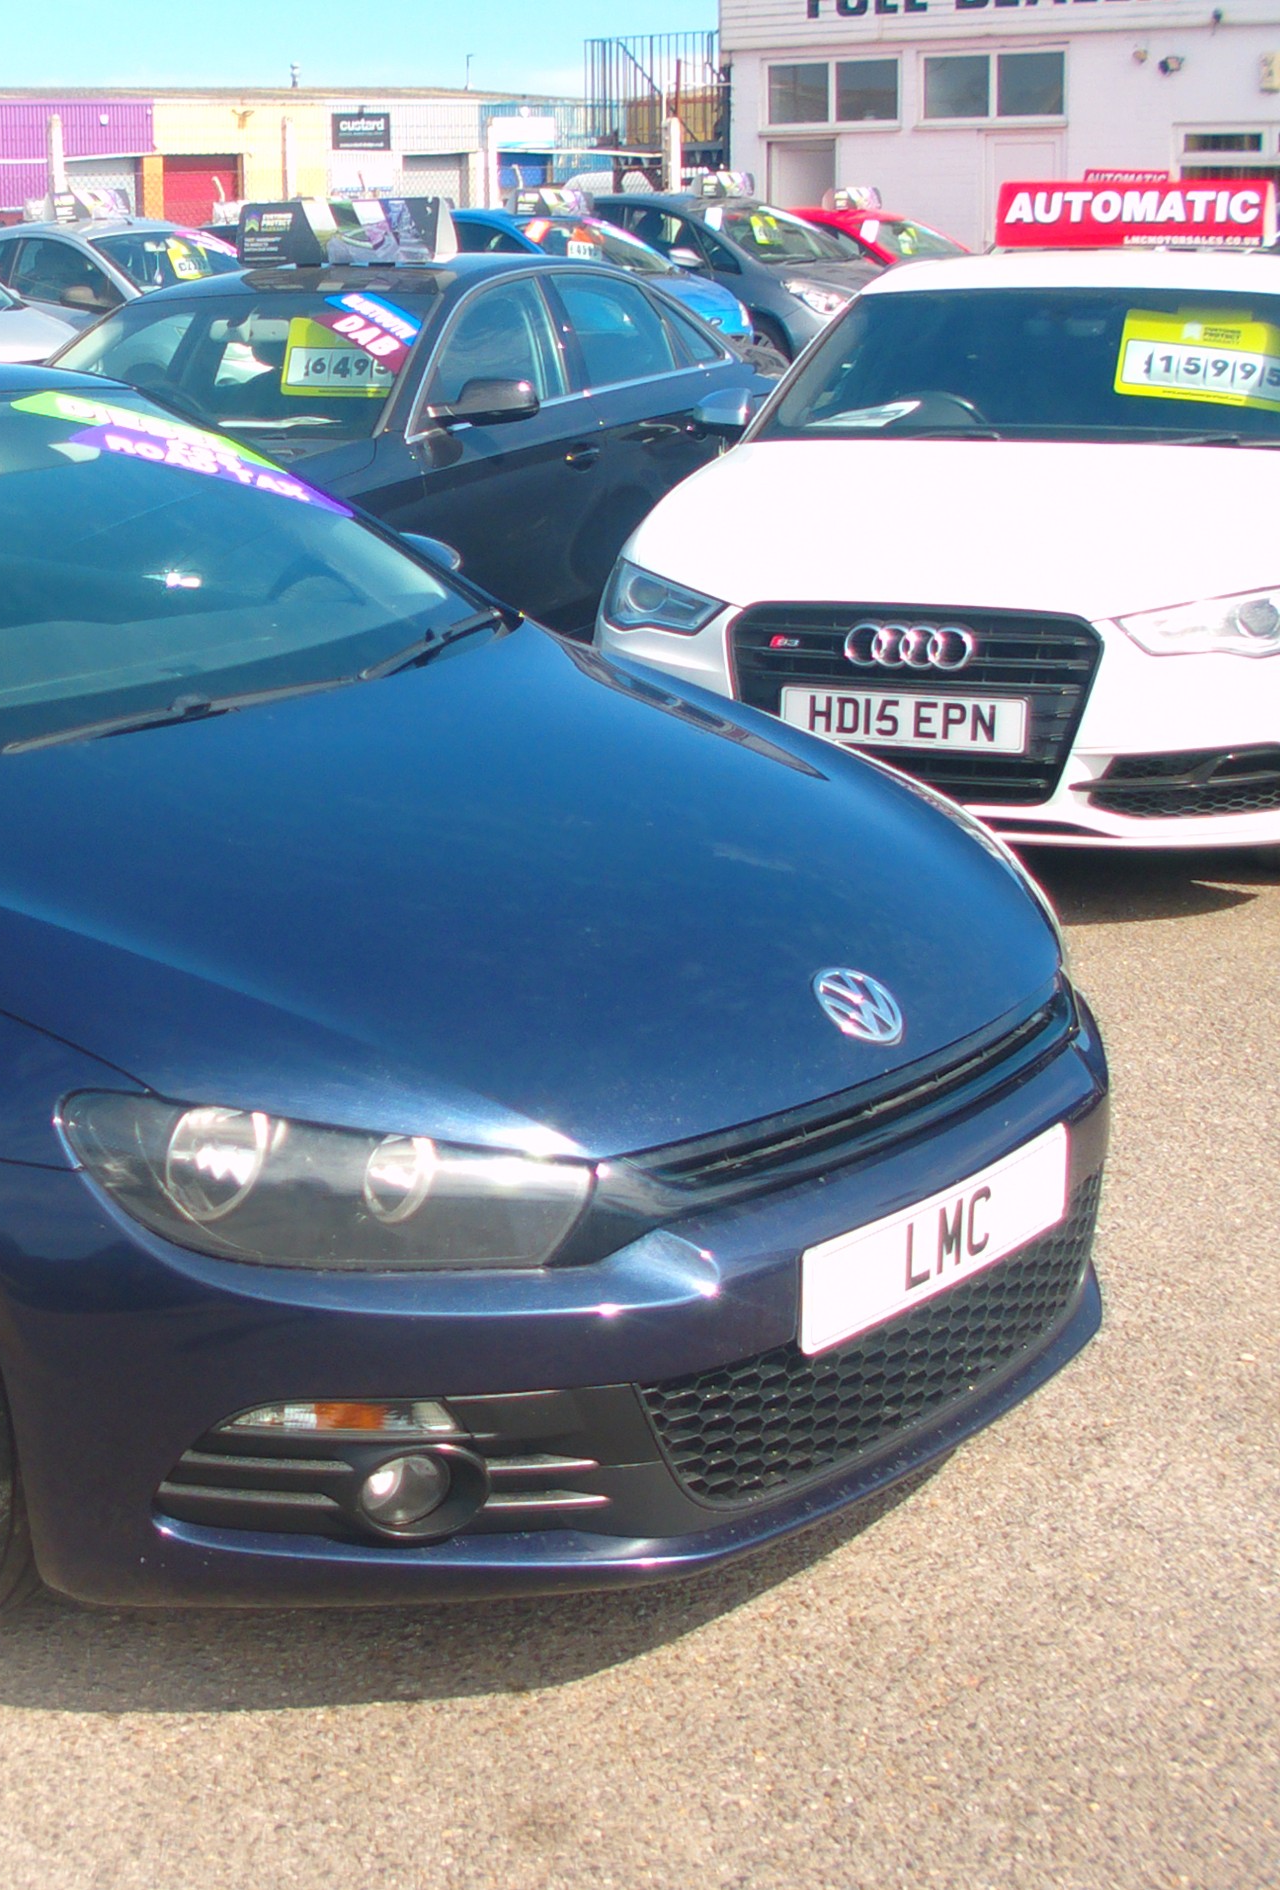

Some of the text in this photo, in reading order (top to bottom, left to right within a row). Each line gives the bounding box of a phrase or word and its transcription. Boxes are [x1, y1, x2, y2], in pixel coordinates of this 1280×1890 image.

[340, 118, 384, 131] custard
[1004, 190, 1261, 224] AUTOMATIC
[1123, 236, 1261, 246] LMCMOTORSALES.CO.UK
[333, 314, 400, 356] DAB
[55, 397, 238, 457] DIESEL
[105, 434, 310, 501] ROAD TAX
[808, 695, 997, 742] HD15 EPN
[905, 1186, 992, 1291] LMC
